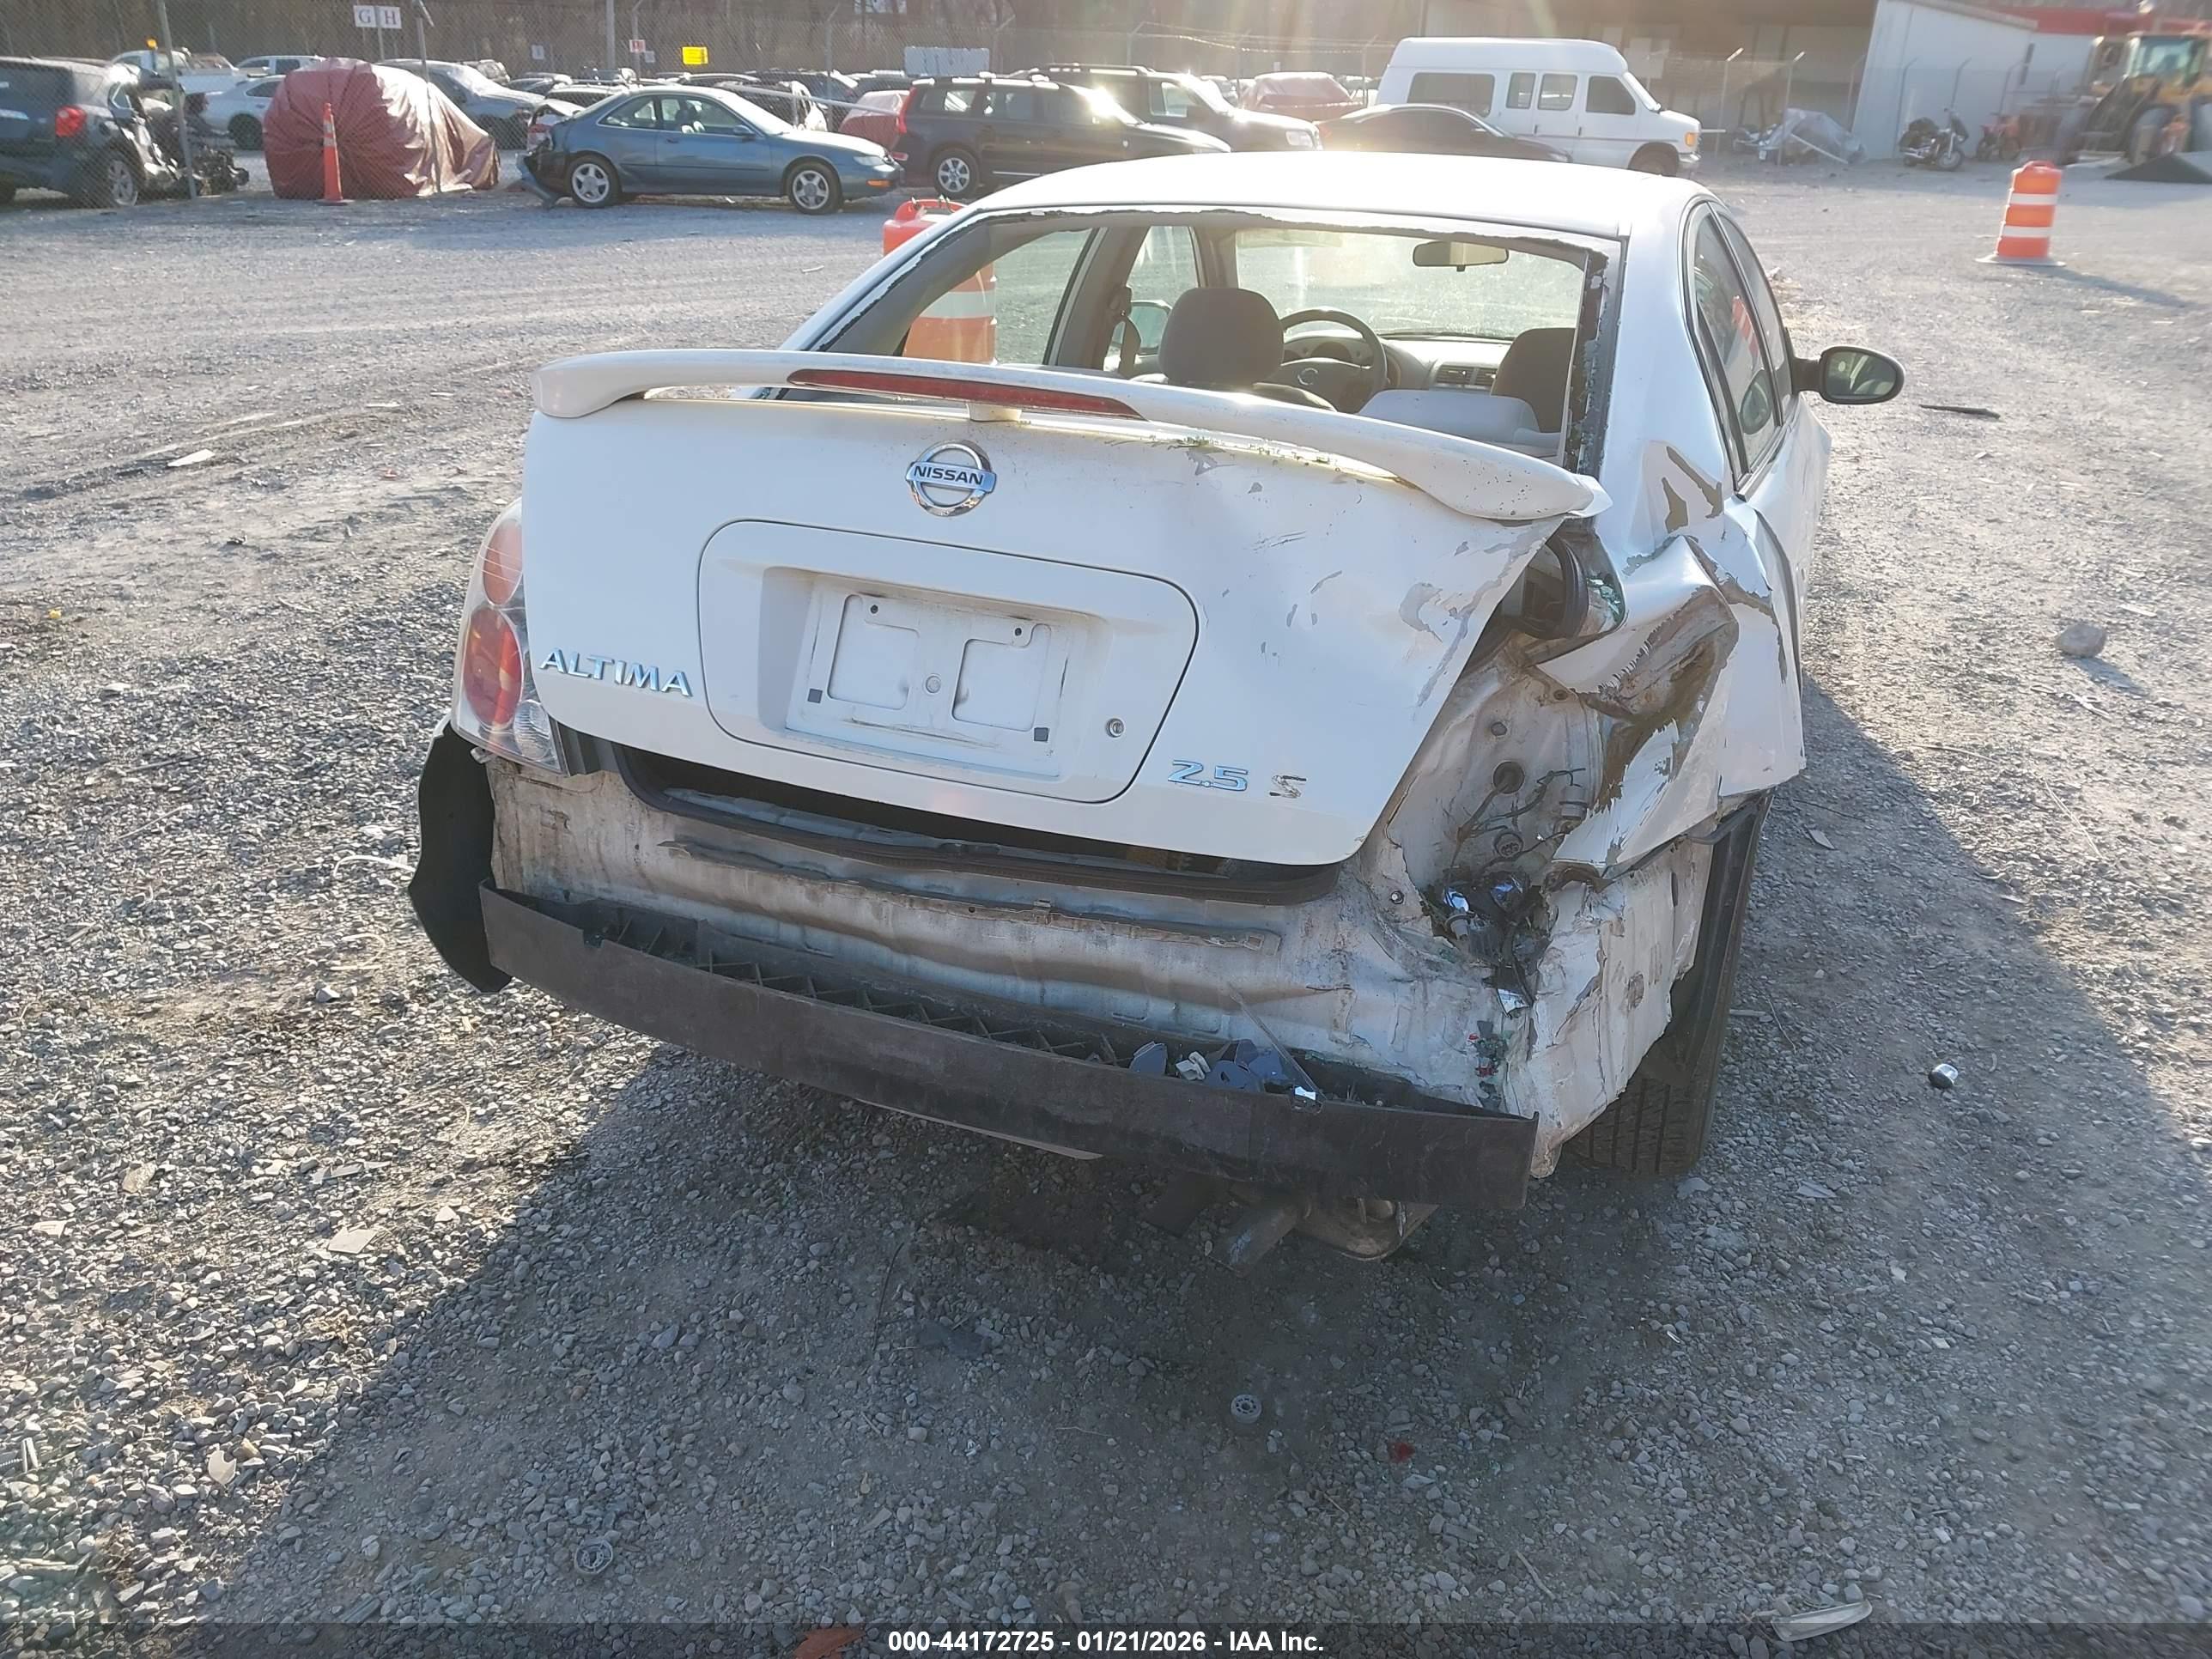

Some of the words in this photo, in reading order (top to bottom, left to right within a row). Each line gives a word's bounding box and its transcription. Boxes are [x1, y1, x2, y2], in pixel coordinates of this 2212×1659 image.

[358, 9, 371, 23] G
[384, 10, 397, 25] H
[914, 465, 984, 485] NISSAN
[539, 647, 693, 697] ALTIMA
[1168, 759, 1248, 791] 2.5
[1269, 775, 1307, 799] S
